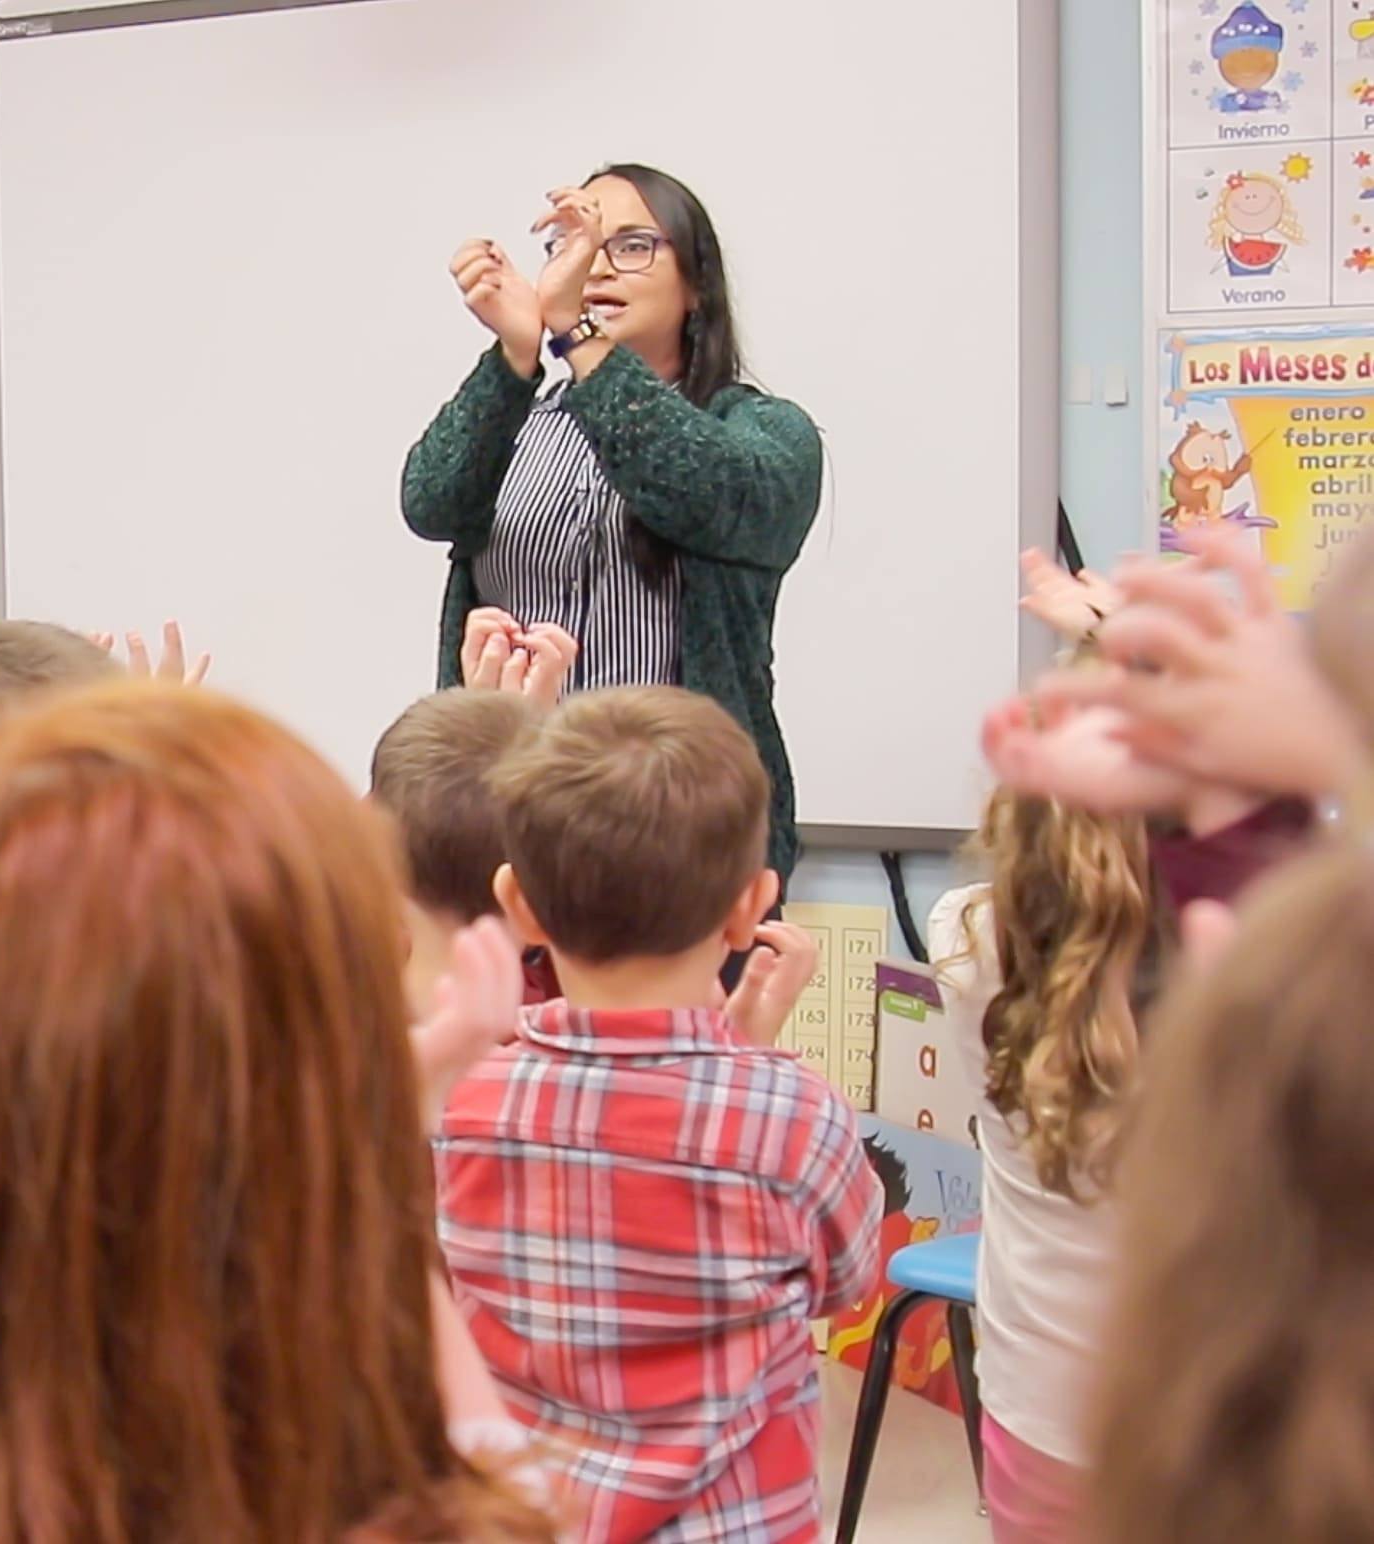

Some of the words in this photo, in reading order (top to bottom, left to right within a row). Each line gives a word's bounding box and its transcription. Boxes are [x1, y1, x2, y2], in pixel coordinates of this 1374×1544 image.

[1218, 122, 1290, 140] Invierno
[1222, 287, 1286, 305] Verano
[1189, 360, 1231, 384] Los
[1239, 346, 1348, 385] Meses
[1290, 406, 1365, 421] enero
[1311, 473, 1373, 495] abril
[1311, 502, 1374, 523] may
[848, 940, 873, 954] 171
[848, 976, 876, 991] 172
[799, 1010, 826, 1024] 163
[920, 1044, 936, 1078] a
